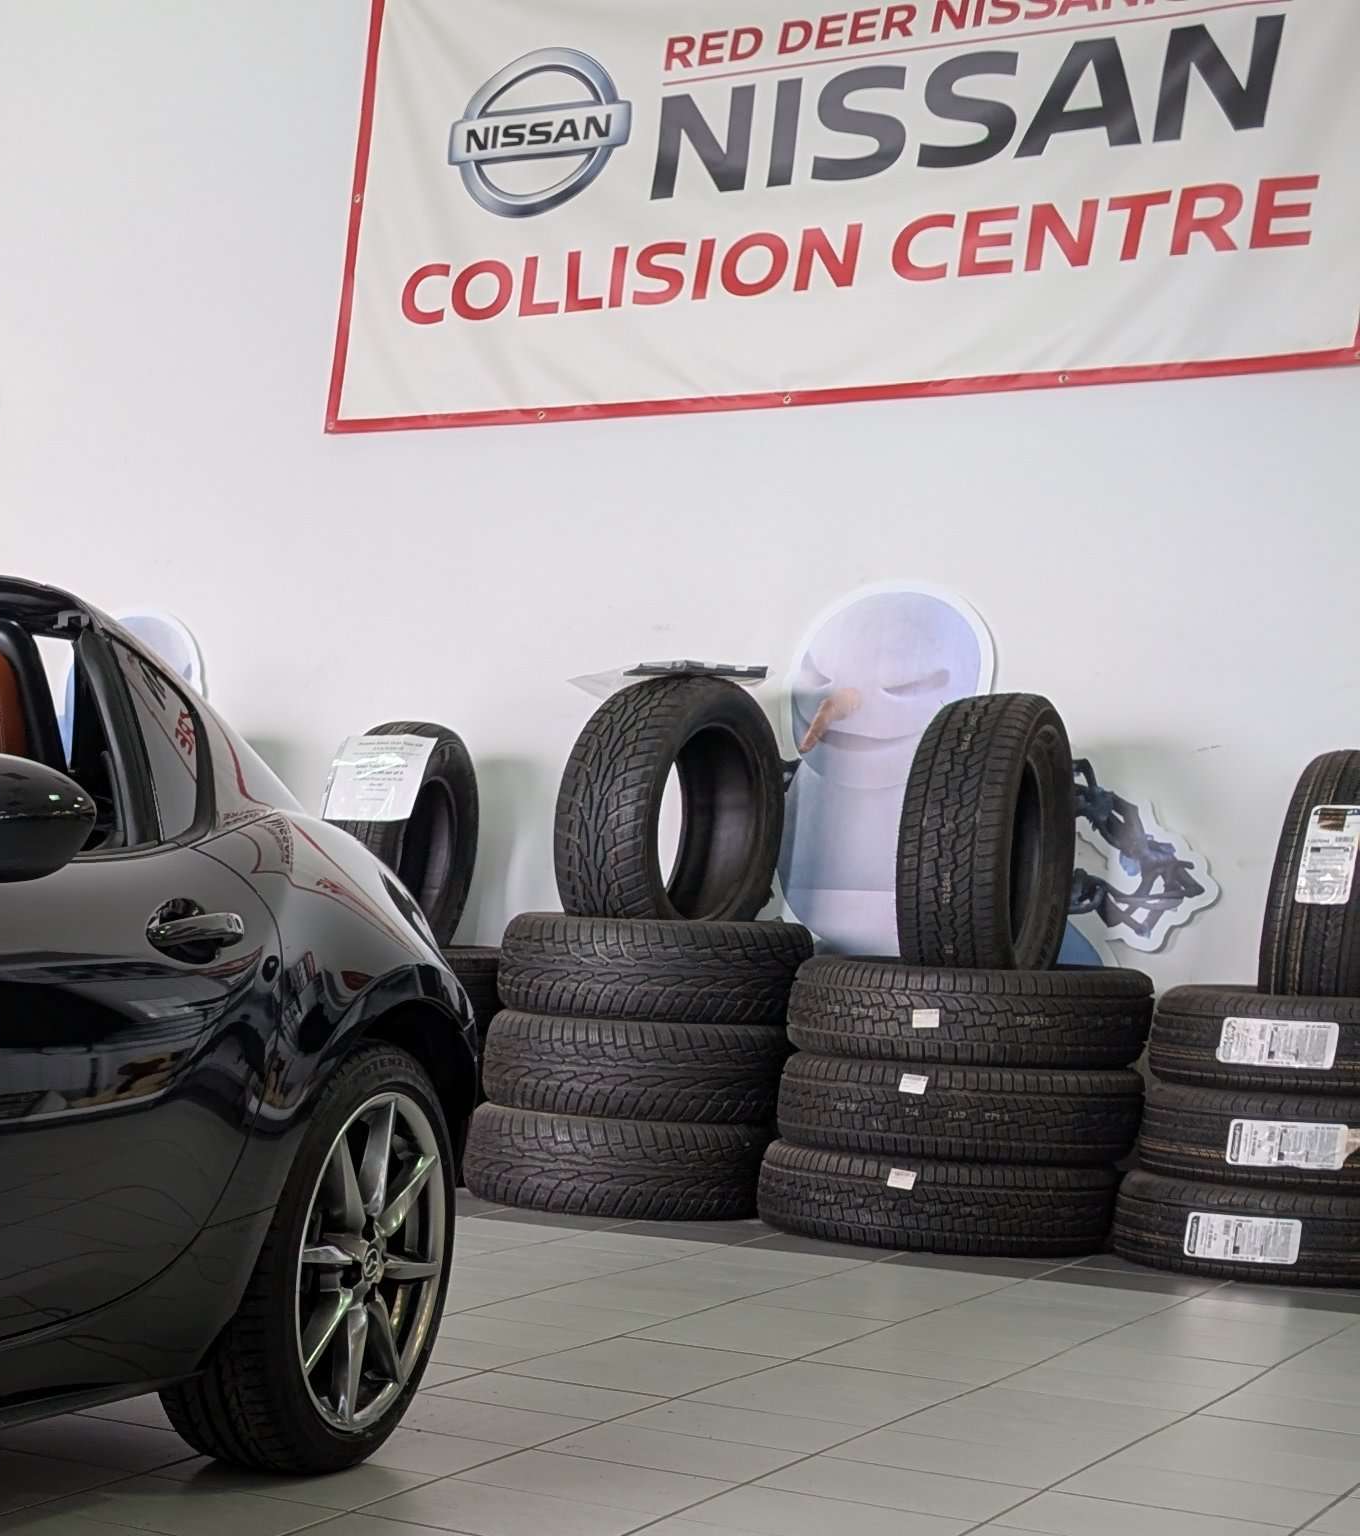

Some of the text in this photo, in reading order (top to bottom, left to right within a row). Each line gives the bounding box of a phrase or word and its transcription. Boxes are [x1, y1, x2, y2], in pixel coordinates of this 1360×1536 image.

[664, 26, 763, 71] RED
[778, 4, 918, 55] DEER
[465, 113, 612, 153] NISSAN
[649, 14, 1286, 201] NISSAN
[401, 174, 1320, 325] COLLISION CENTRE
